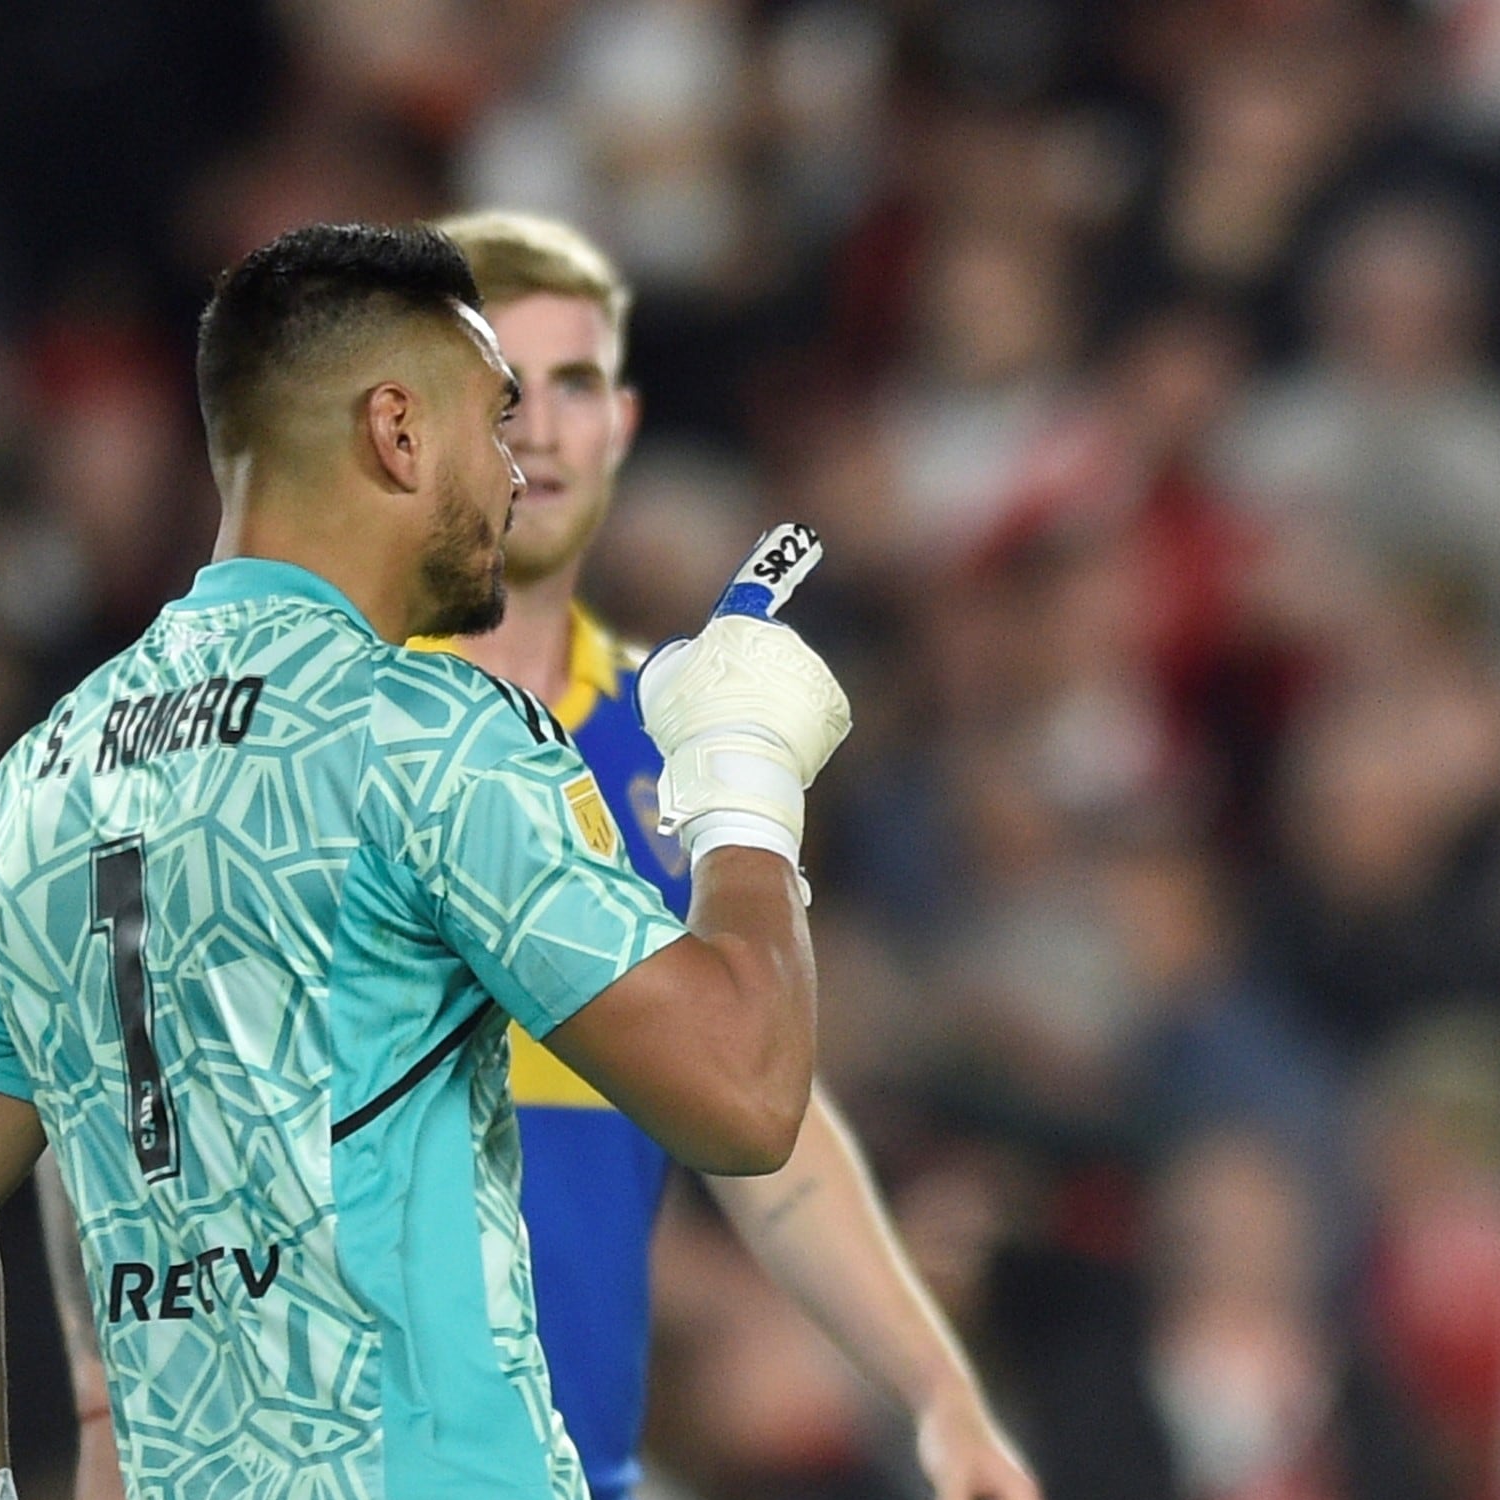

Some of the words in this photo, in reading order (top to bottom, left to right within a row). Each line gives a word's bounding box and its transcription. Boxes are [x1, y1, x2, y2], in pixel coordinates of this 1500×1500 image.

[753, 523, 819, 584] SR22
[37, 709, 73, 778] S.
[93, 674, 267, 776] ROMERO
[90, 834, 179, 1184] 1
